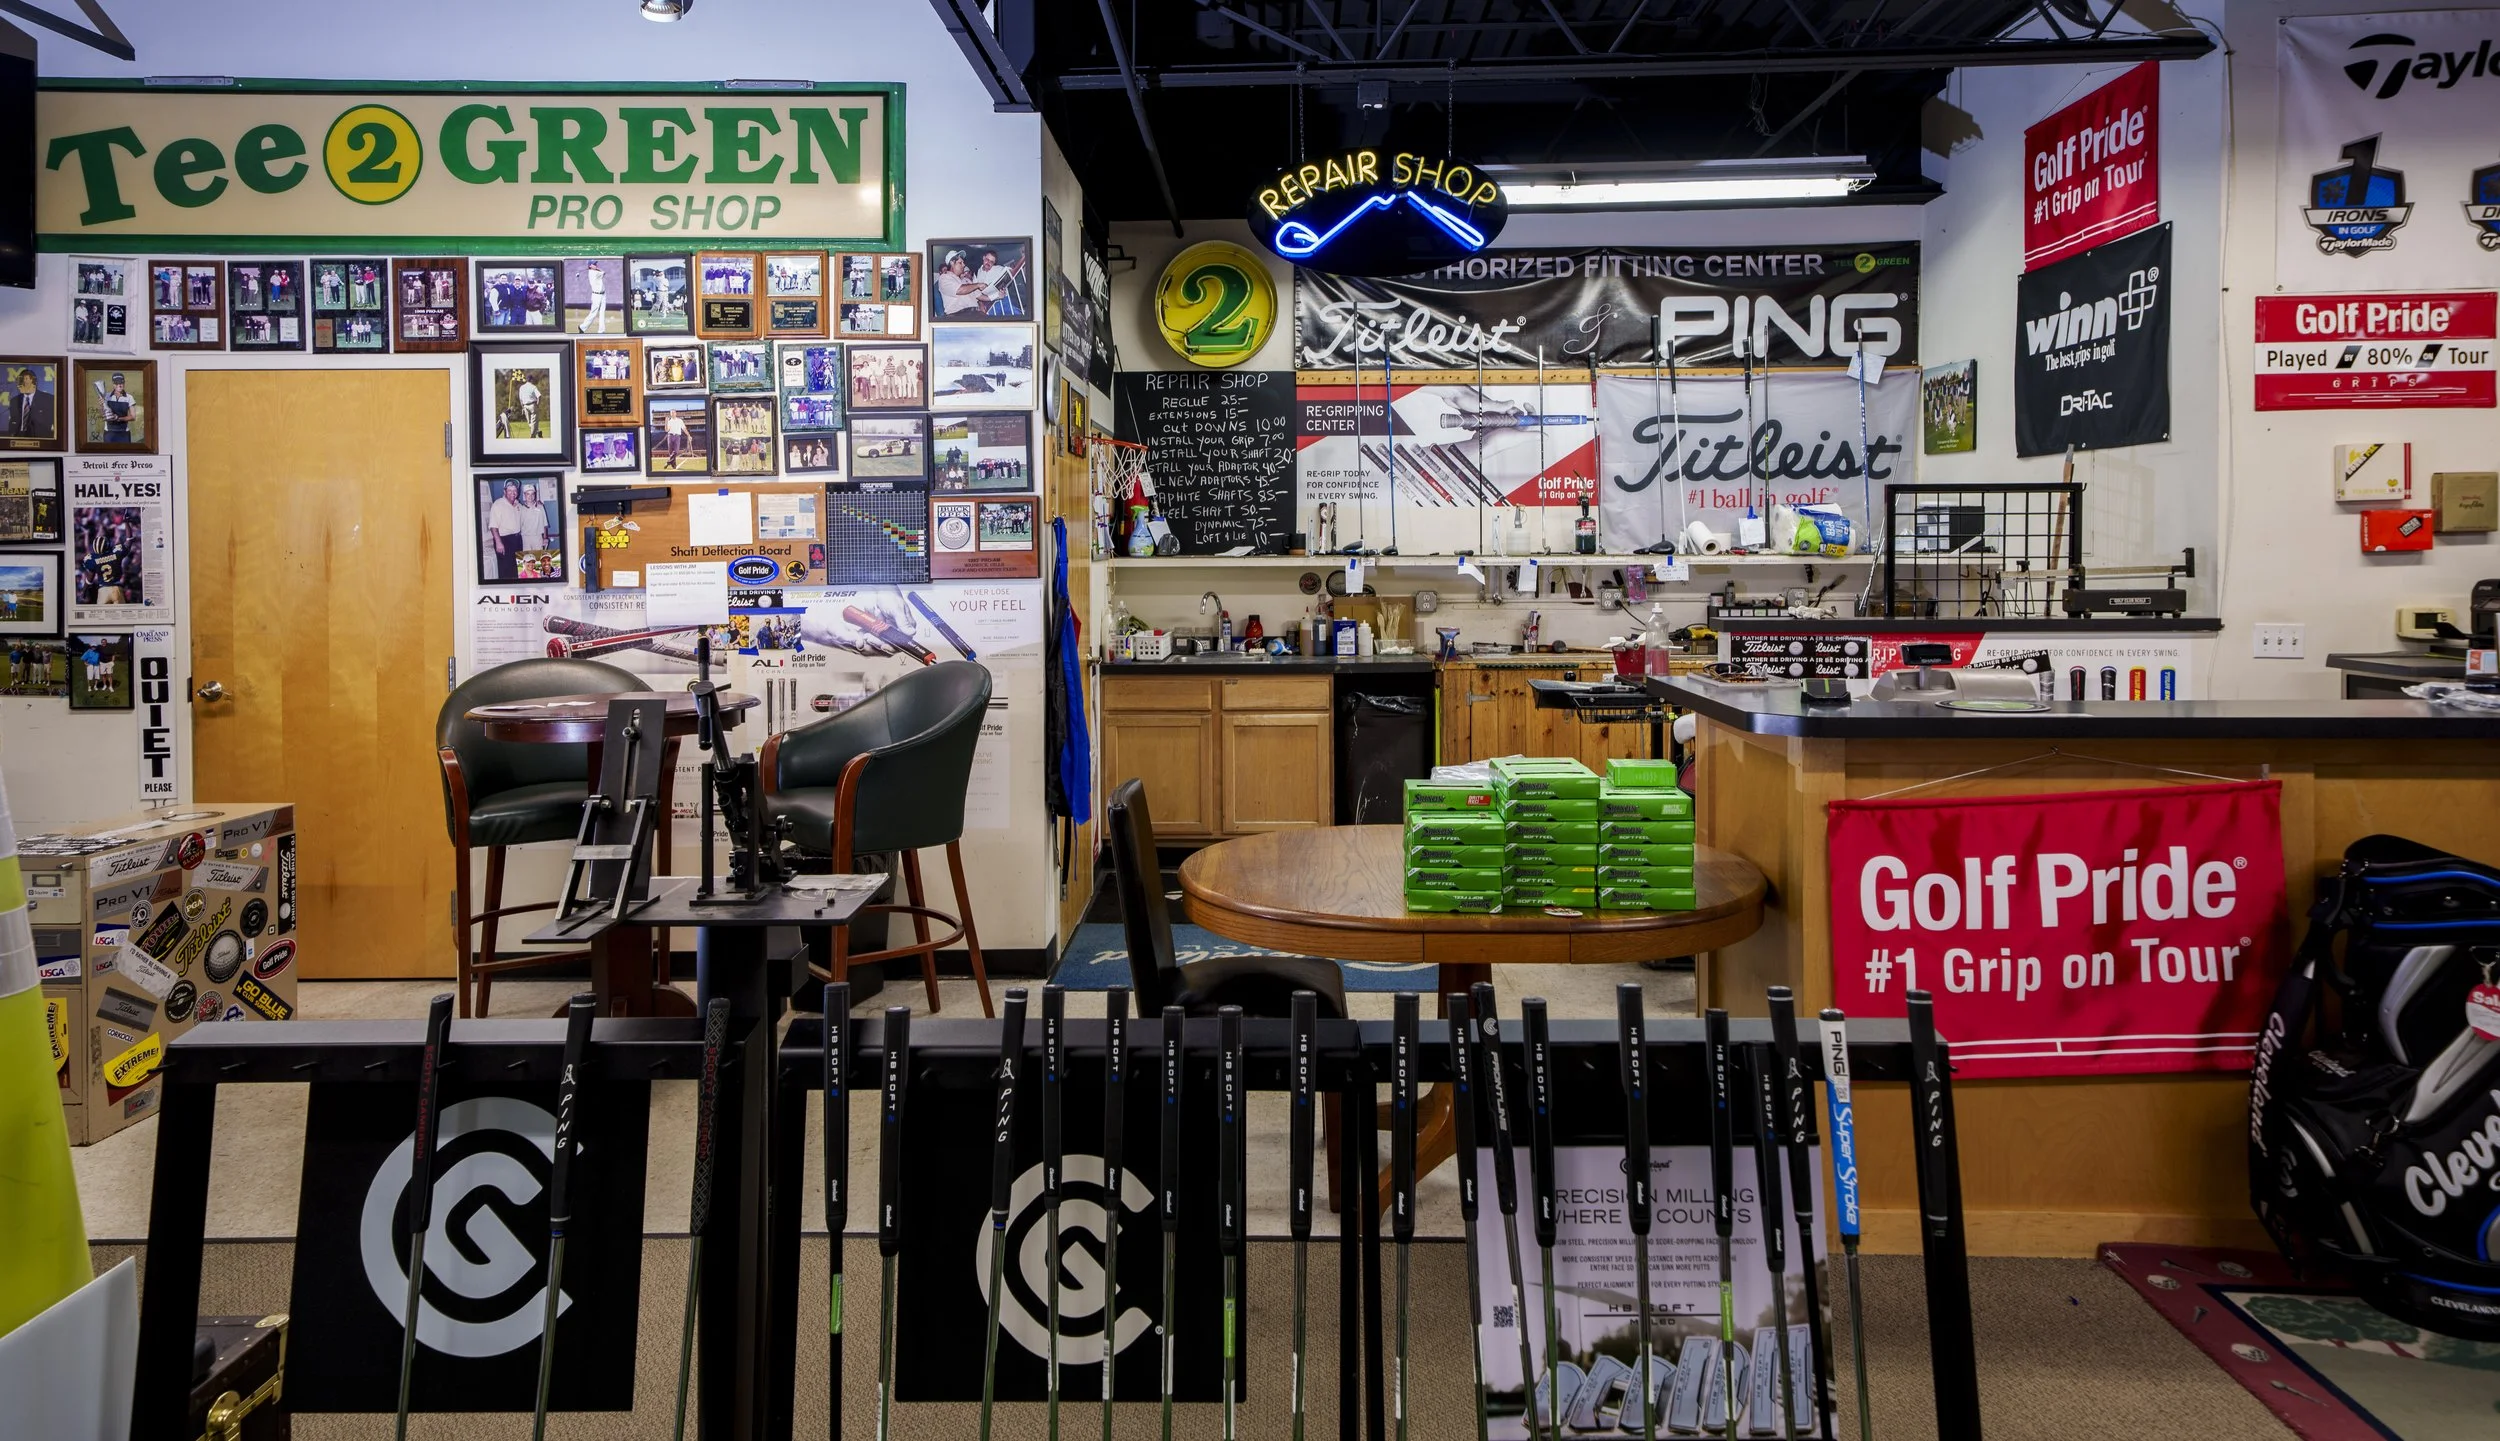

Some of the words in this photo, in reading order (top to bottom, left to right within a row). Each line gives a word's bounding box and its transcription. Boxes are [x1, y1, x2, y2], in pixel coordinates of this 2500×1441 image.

[2034, 138, 2078, 192] Golf
[2080, 105, 2145, 170] Pride
[46, 124, 310, 227] Tee
[347, 123, 402, 183] 2
[439, 104, 868, 184] GREEN
[1259, 150, 1379, 219] REPAIR
[1392, 151, 1498, 207] SHOP
[2034, 194, 2050, 225] #1
[2052, 185, 2082, 216] Grip
[2084, 177, 2100, 204] on
[2104, 161, 2145, 192] Tour
[527, 195, 623, 230] PRO
[650, 195, 782, 231] SHOP
[2326, 208, 2388, 223] IRONS
[2338, 226, 2350, 235] IN
[2350, 226, 2376, 234] GOLF
[2320, 236, 2392, 251] TaylorMade
[1584, 255, 1694, 278] FITTING
[1704, 254, 1825, 277] CENTER
[1876, 257, 1910, 266] GREEN
[1181, 263, 1258, 354] 2
[2026, 291, 2119, 356] winn
[2296, 302, 2360, 334] Golf
[2367, 301, 2449, 334] Pride
[1302, 298, 1521, 359] Titleist
[1660, 293, 1902, 359] PING
[2045, 354, 2060, 372] The
[2060, 350, 2074, 368] best
[2092, 342, 2100, 360] in
[2101, 338, 2116, 362] golf
[2266, 350, 2327, 370] Played
[2344, 354, 2354, 362] BY
[2367, 348, 2412, 366] 80%
[2422, 352, 2434, 360] ON
[2448, 348, 2489, 364] Tour
[1146, 373, 1210, 391] REPAIR
[1220, 372, 1269, 390] SHOP
[2332, 378, 2418, 388] GRIPS
[1162, 396, 1210, 409] REGLUE
[1149, 410, 1217, 420] EXTENSIONS
[1306, 405, 1384, 418] RE-GRIPPING
[1195, 421, 1247, 433] DOWNS
[1306, 420, 1354, 432] CENTER
[1147, 436, 1194, 446] INSTALL
[1148, 448, 1198, 461] INSTALL
[1240, 448, 1270, 460] SHAFT
[1614, 408, 1902, 493] Titleist
[83, 461, 108, 469] Detroit
[111, 461, 128, 469] Free
[130, 461, 153, 469] Press
[1168, 476, 1196, 487] NEW
[1306, 470, 1340, 478] RE-GRIP
[1343, 470, 1370, 478] TODAY
[1538, 477, 1562, 490] Golf
[1564, 477, 1594, 490] Pride
[75, 484, 120, 500] HAIL,
[121, 483, 160, 498] YES!
[1208, 488, 1254, 502] SHAFTS
[1538, 491, 1548, 499] #1
[1550, 491, 1565, 500] Grip
[1580, 491, 1594, 499] Tour
[1688, 489, 1705, 508] #1
[1712, 488, 1750, 508] ball
[1758, 488, 1776, 507] in
[1192, 505, 1236, 518] SHAFT
[1195, 520, 1244, 534] DYNAMIC
[1195, 534, 1220, 544] LOFT
[670, 546, 698, 557] Shaft
[702, 545, 754, 556] Deflection
[759, 545, 792, 556] Board
[101, 564, 113, 582] 2
[738, 566, 752, 575] Golf
[752, 566, 769, 574] Pride
[477, 594, 550, 604] ALIGN
[950, 600, 988, 612] YOUR
[993, 600, 1026, 611] FEEL
[1742, 640, 1786, 654] Titleist
[2050, 649, 2064, 657] FOR
[2066, 649, 2114, 657] CONFIDENCE
[808, 654, 826, 662] Pride
[140, 657, 172, 778] QUIET
[144, 782, 172, 793] PLEASE
[224, 828, 248, 840] PRO
[252, 821, 268, 831] V1
[108, 856, 150, 877] Titleist
[280, 850, 290, 898] Titleist
[207, 869, 242, 884] Titleist
[1860, 854, 2016, 932] Golf
[2036, 846, 2236, 928] Pride
[96, 895, 127, 910] PRO
[132, 886, 150, 898] V1
[186, 899, 204, 912] PGA
[96, 936, 115, 945] USGA
[175, 896, 232, 977] Titleist
[262, 957, 274, 970] Golf
[274, 950, 288, 962] Pride
[40, 966, 66, 978] USGA
[1864, 947, 1917, 993] #1
[1943, 947, 2041, 1002] Grip
[2062, 950, 2114, 990] on
[2130, 938, 2240, 984] Tour
[242, 980, 260, 998] GO
[258, 992, 288, 1019] BLUE
[1830, 1031, 1846, 1076] PING
[114, 1047, 159, 1081] EXTREME!
[1491, 1051, 1507, 1131] FRONTLINE
[557, 1093, 572, 1149] PING
[998, 1088, 1012, 1142] PING
[1588, 1238, 1618, 1246] PRECISION
[1609, 1304, 1632, 1312] HB
